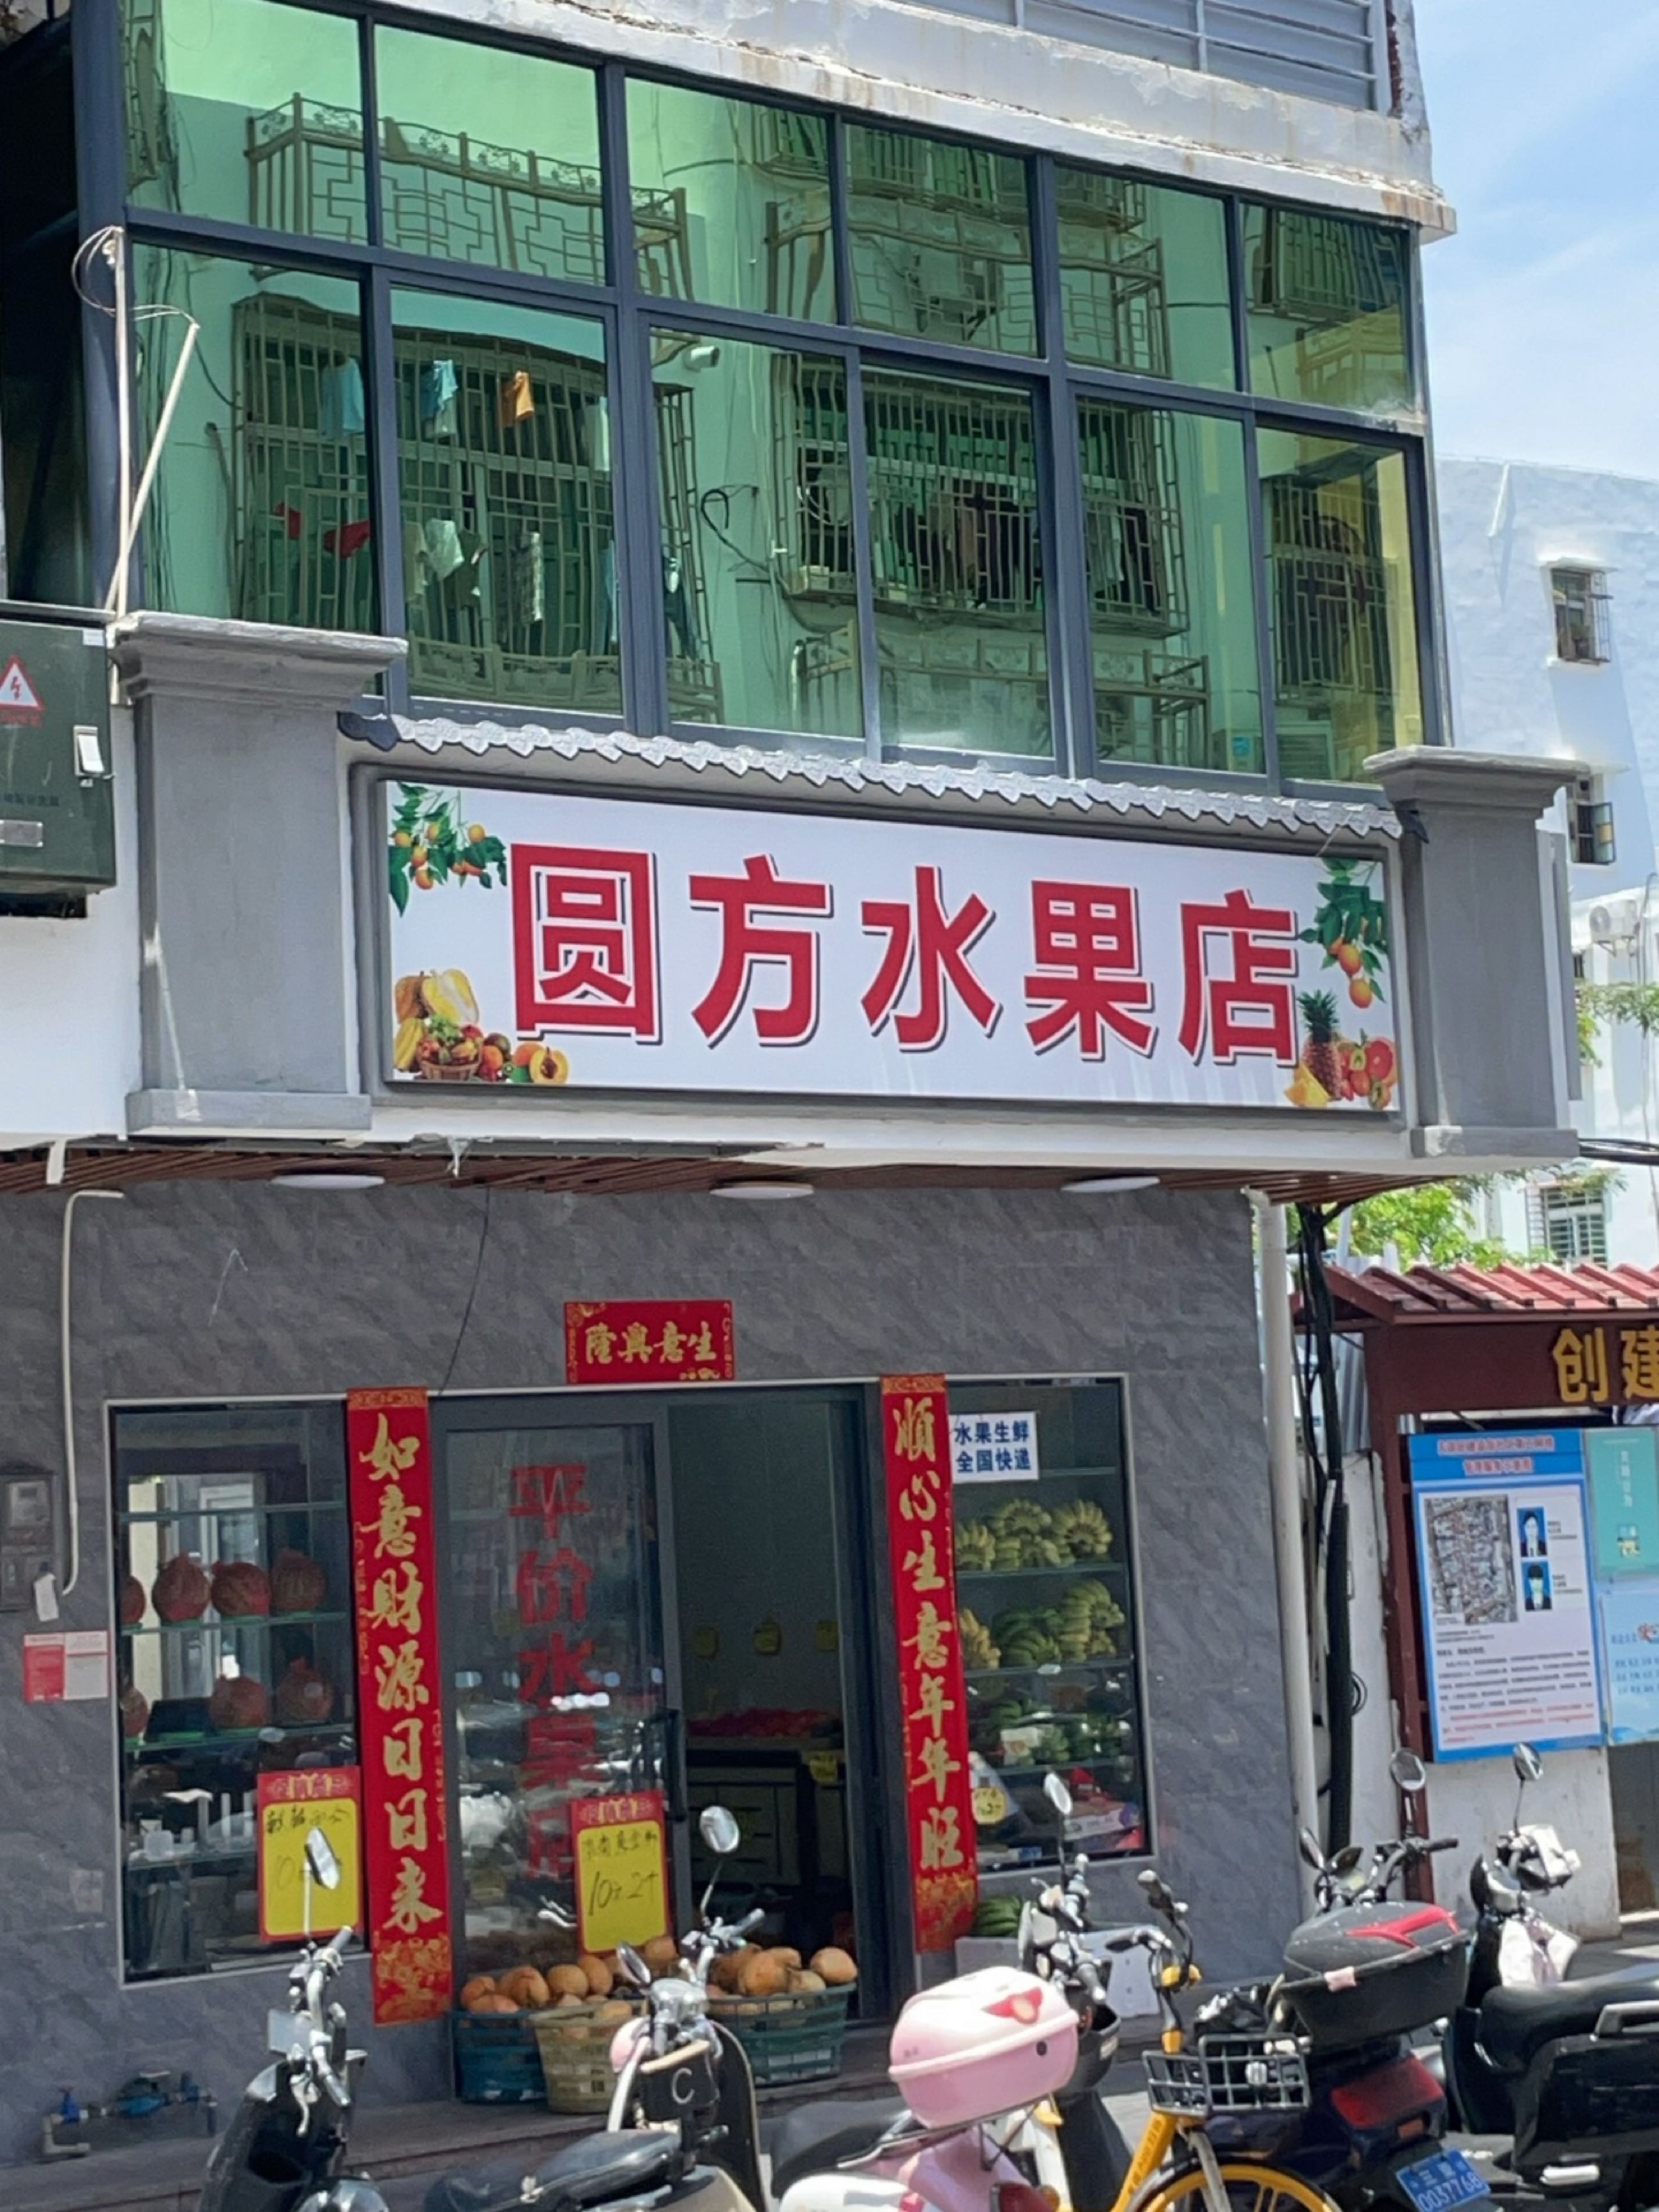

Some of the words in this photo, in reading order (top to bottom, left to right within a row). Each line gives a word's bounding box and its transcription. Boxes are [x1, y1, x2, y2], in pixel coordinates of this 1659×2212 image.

[513, 844, 1298, 1066] 圆方水果店
[1553, 1324, 1659, 1402] 创建
[954, 1420, 1030, 1446] 水果生鲜
